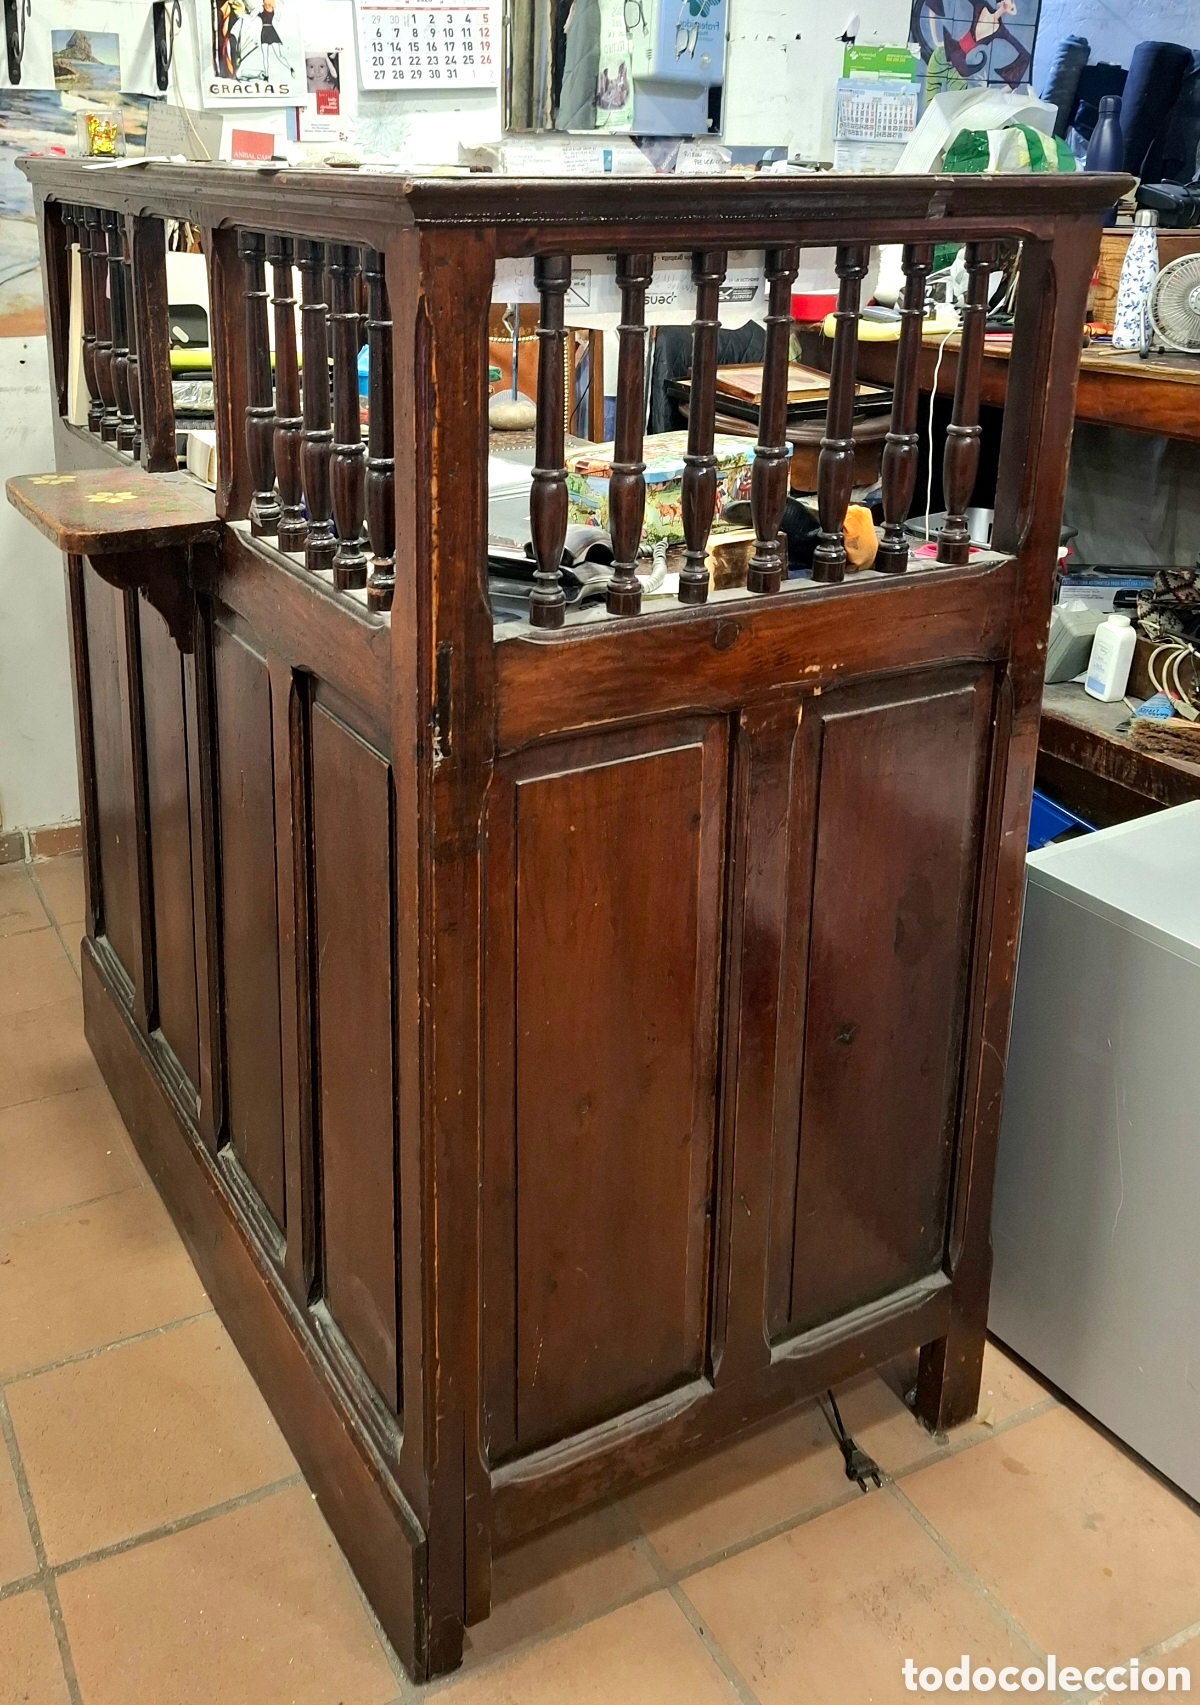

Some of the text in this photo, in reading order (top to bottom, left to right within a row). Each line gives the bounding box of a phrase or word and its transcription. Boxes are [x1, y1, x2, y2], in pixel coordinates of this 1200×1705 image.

[372, 14, 488, 24] 29 30 1 2 3 4 5
[376, 28, 489, 37] 6 7 8 9 10 11 12
[372, 41, 490, 52] 13 14 15 16 17 18 19
[372, 55, 491, 66] 20 21 22 23 24 25 26
[374, 70, 385, 79] 27
[392, 70, 404, 79] 28
[411, 70, 422, 79] 29
[429, 70, 440, 78] 30
[447, 69, 457, 78] 31
[210, 82, 290, 94] GRACIAS
